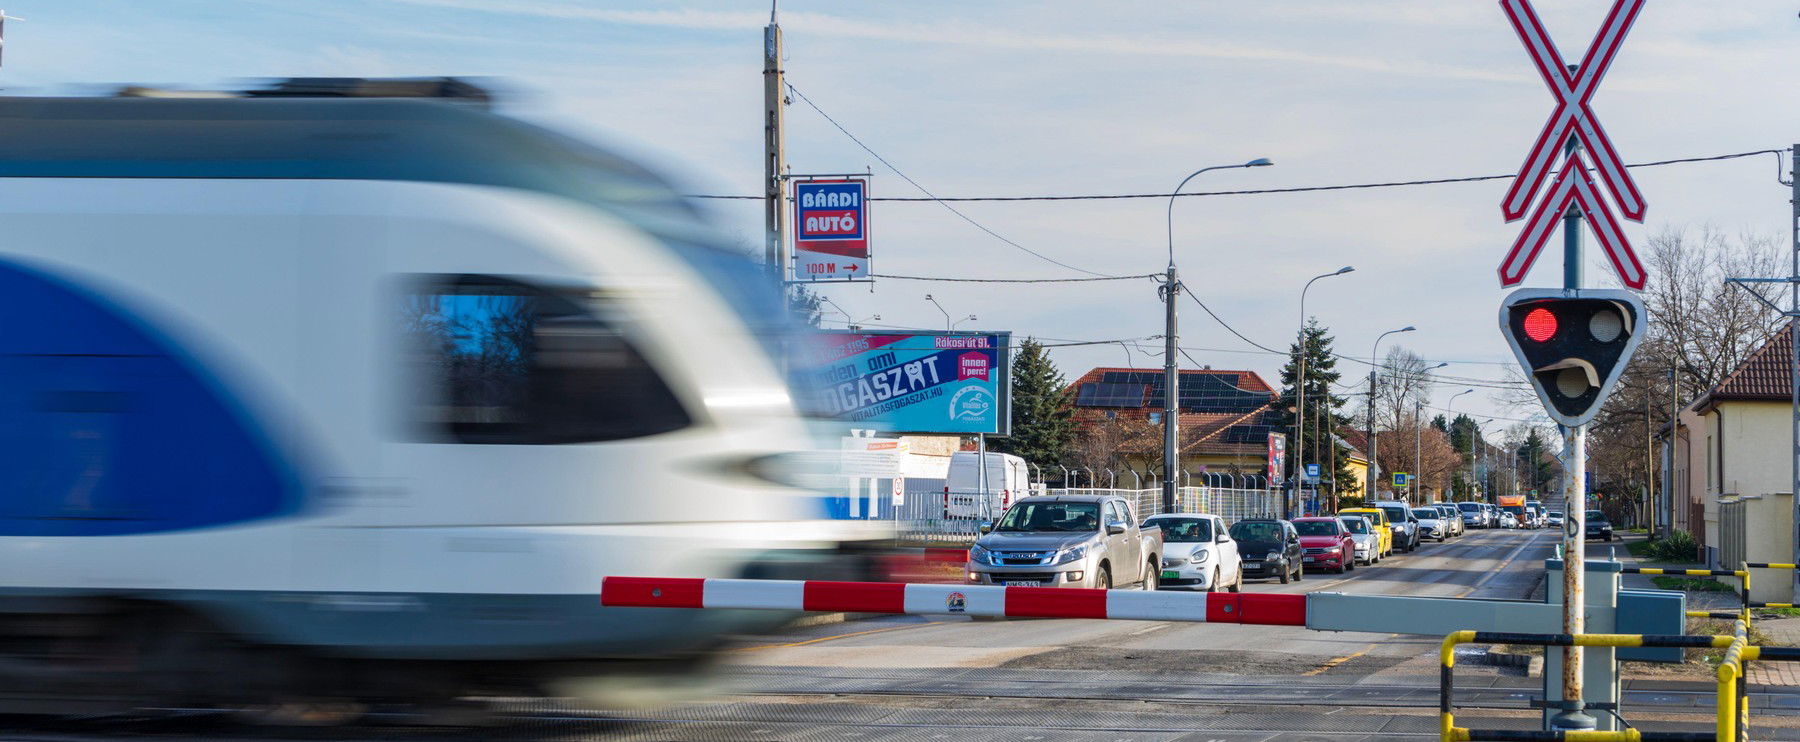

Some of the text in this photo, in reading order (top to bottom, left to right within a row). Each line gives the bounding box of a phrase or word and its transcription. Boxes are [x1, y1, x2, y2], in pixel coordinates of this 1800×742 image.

[803, 189, 858, 207] BÁRDI
[807, 212, 855, 231] AUTÓ
[806, 263, 836, 274] 100 M
[935, 335, 990, 348] Rákosi út 91.
[867, 351, 897, 370] ami
[962, 357, 986, 366] innen
[962, 367, 986, 376] 1 perc!
